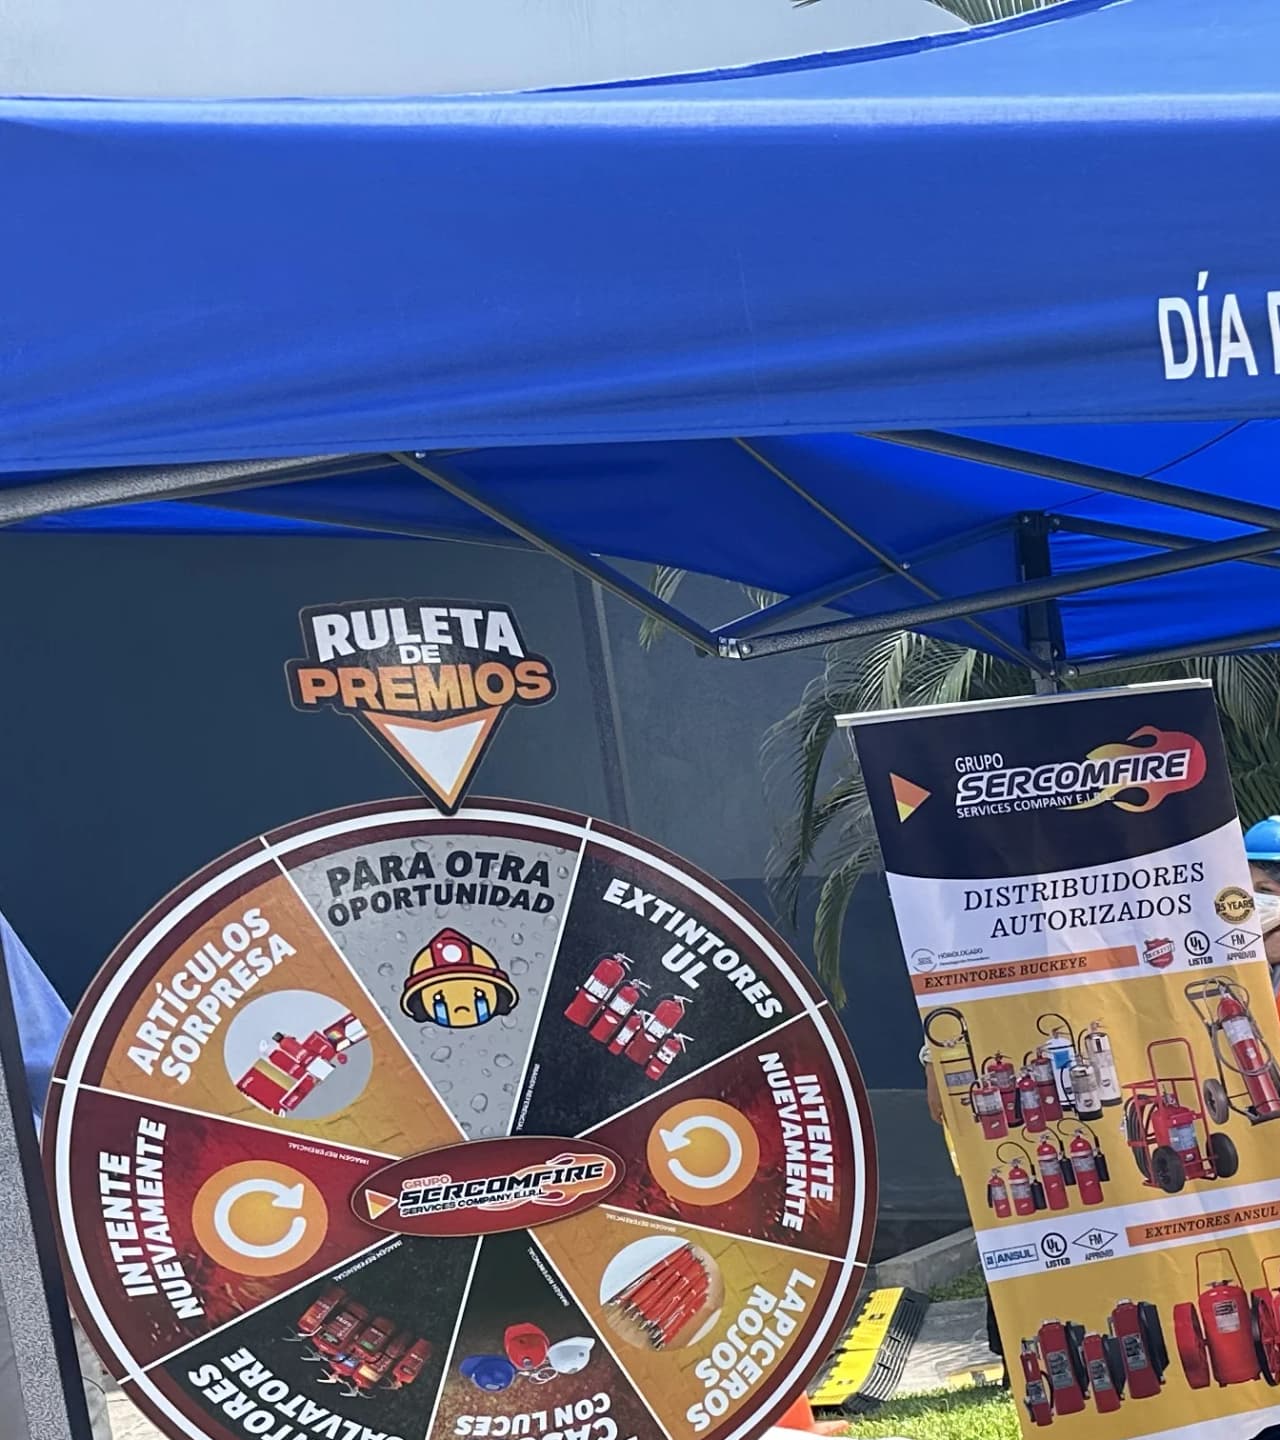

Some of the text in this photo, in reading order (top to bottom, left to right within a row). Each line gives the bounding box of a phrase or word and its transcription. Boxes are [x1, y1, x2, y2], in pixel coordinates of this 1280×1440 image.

[1157, 271, 1259, 380] DÍA
[312, 607, 525, 662] RULETA
[399, 644, 441, 664] DE
[297, 661, 551, 712] PREMIOS
[955, 753, 1004, 773] GRUPO
[956, 750, 1190, 805] SERCOMFIRE
[956, 803, 1011, 819] SERVICES
[1013, 796, 1074, 812] COMPANY
[326, 850, 550, 897] PARA OTRA
[964, 861, 1205, 911] DISTRIBUIDORES
[327, 883, 555, 926] OPORTUNIDAD
[990, 894, 1192, 938] AUTORIZADOS
[1227, 899, 1255, 911] YEARS
[603, 878, 783, 1019] EXTINTORES
[1188, 956, 1214, 967] LISTED
[1231, 934, 1246, 946] FM
[661, 943, 709, 990] UL
[924, 956, 1088, 989] EXTINTORES BUCKEYE
[127, 908, 270, 1076] ARTÍCULOS
[161, 934, 297, 1085] SORPRESA
[758, 1052, 807, 1231] NUEVAMENTE
[794, 1074, 834, 1201] INTENTE
[400, 1163, 604, 1208] SERCOMFIRE
[404, 1175, 450, 1190] GRUPO
[99, 1152, 158, 1297] INTENTE
[135, 1117, 204, 1320] NUEVAMENTE
[401, 1201, 456, 1217] SERVICES
[457, 1195, 511, 1209] COMPANY
[1144, 1205, 1279, 1239] EXTINTORES ANSUL
[996, 1249, 1034, 1263] ANSUL
[1045, 1257, 1071, 1268] LISTED
[1089, 1234, 1102, 1246] FM
[686, 1268, 816, 1432] LAPICEROS
[695, 1285, 778, 1387] ROJOS
[454, 1392, 611, 1436] CON LUCES
